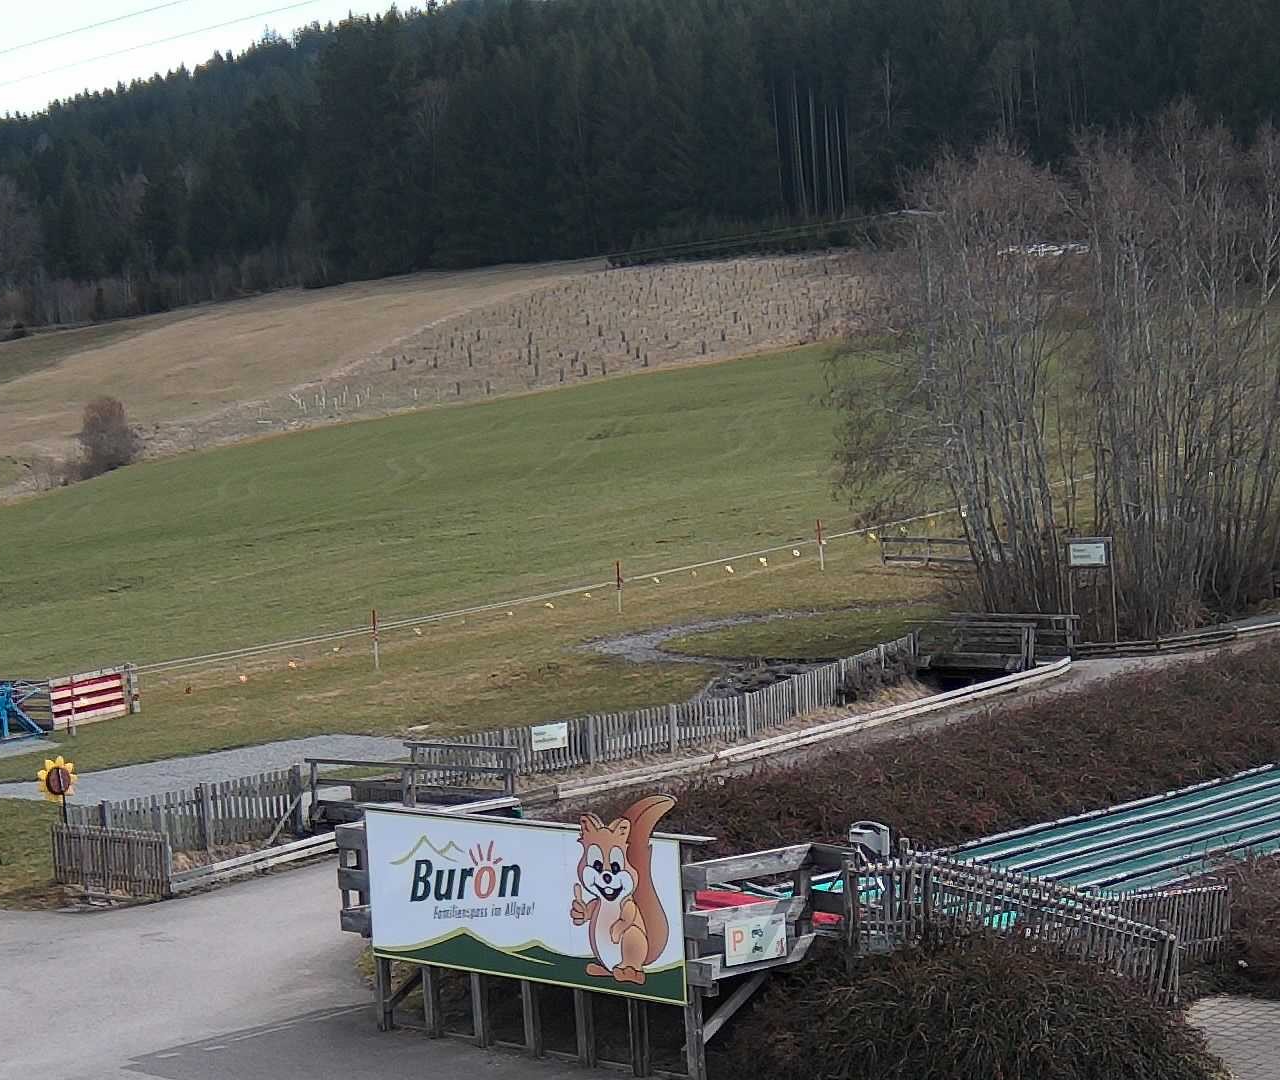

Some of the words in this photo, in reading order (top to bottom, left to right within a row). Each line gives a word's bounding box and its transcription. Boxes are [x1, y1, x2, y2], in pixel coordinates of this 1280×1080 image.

[410, 859, 522, 903] Buron
[491, 903, 502, 917] im
[504, 901, 536, 920] Allgäu!
[733, 929, 745, 952] P
